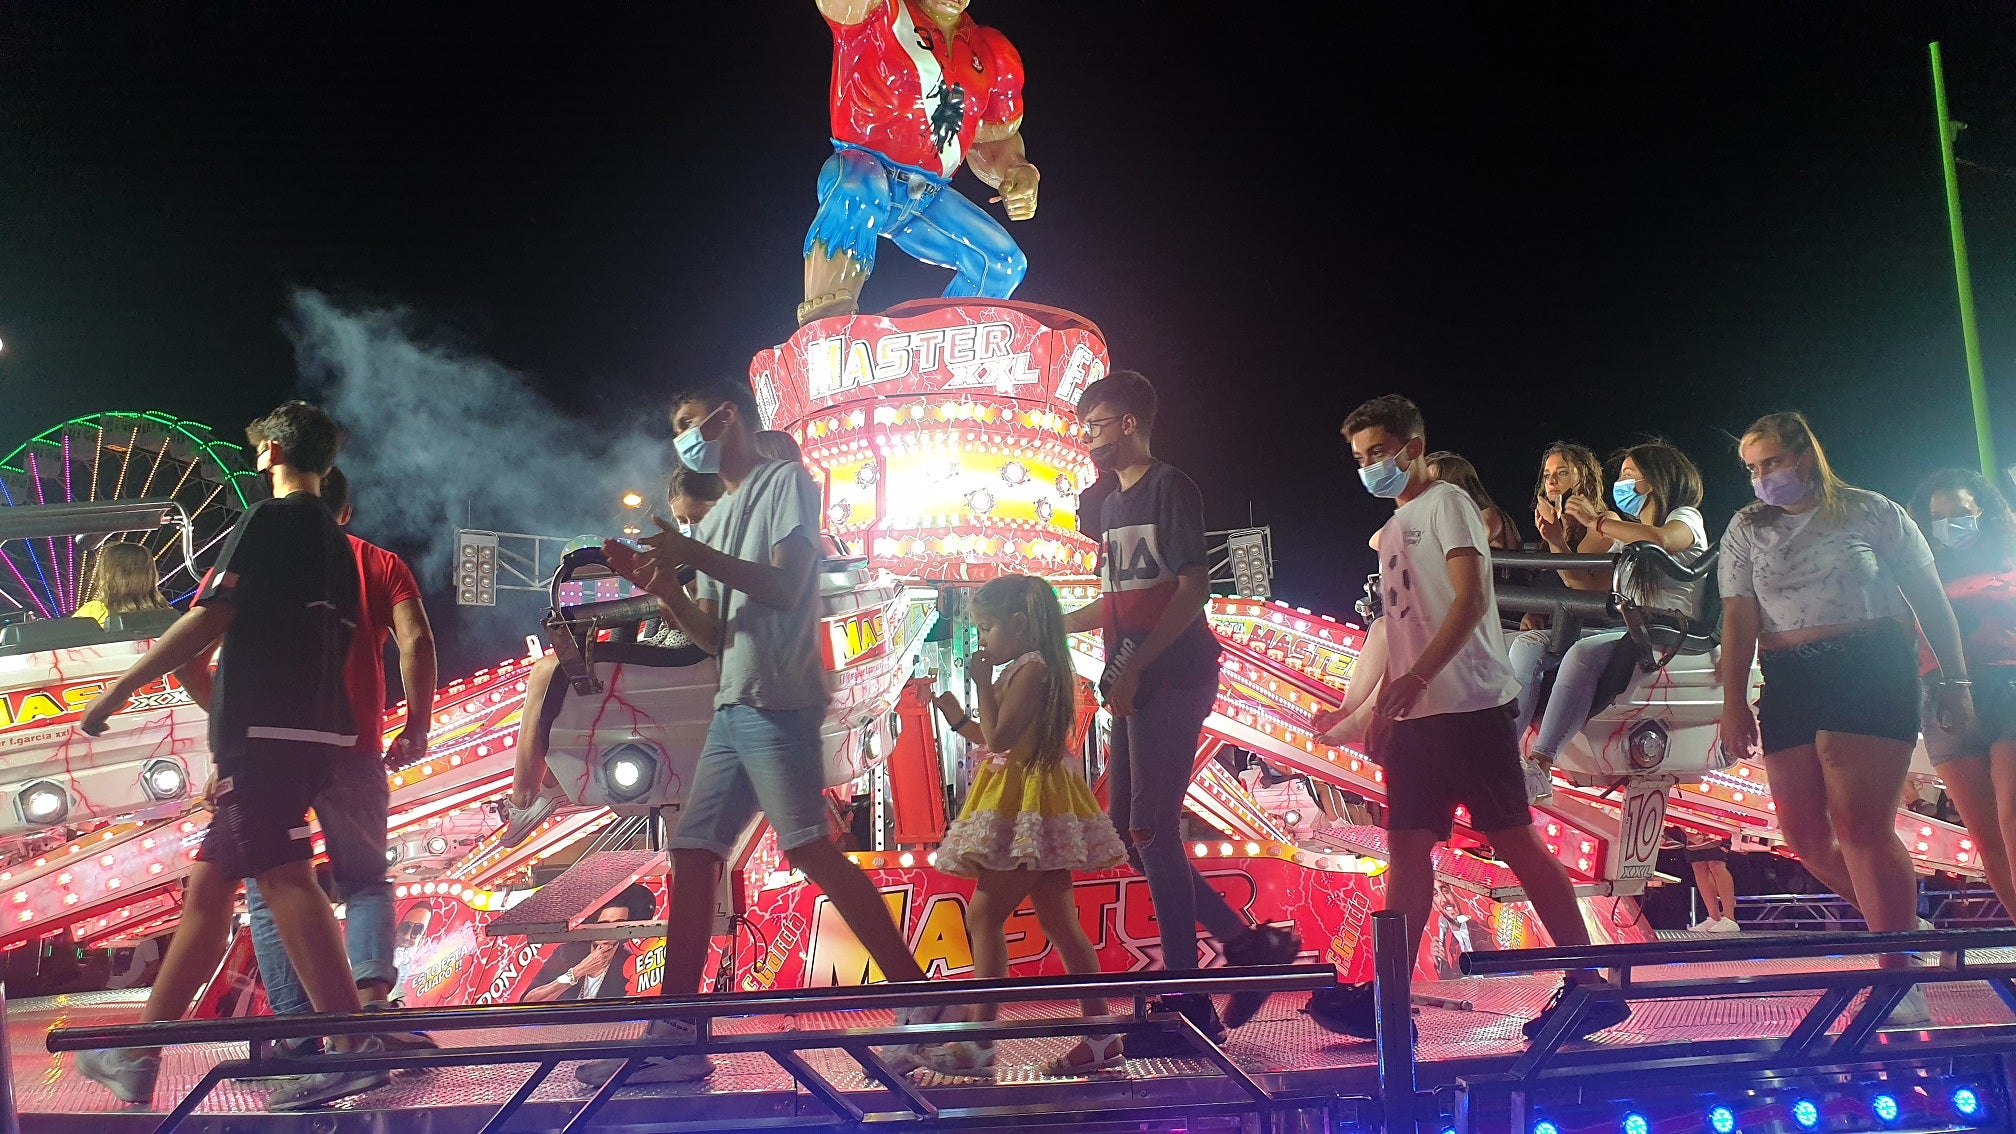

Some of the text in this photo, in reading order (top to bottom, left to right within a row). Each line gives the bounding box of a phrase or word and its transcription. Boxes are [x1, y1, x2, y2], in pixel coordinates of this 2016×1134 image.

[807, 321, 1014, 401] MASTER
[942, 353, 1040, 391] XXL
[832, 614, 885, 662] MAS
[1249, 623, 1359, 680] MASTE
[128, 690, 196, 711] XX
[9, 732, 52, 746] f.garcia
[55, 728, 70, 738] xxl
[1625, 789, 1664, 862] 10
[1620, 865, 1652, 879] XXL
[412, 945, 469, 988] ESTO ESTA
[416, 967, 453, 997] GUAPO
